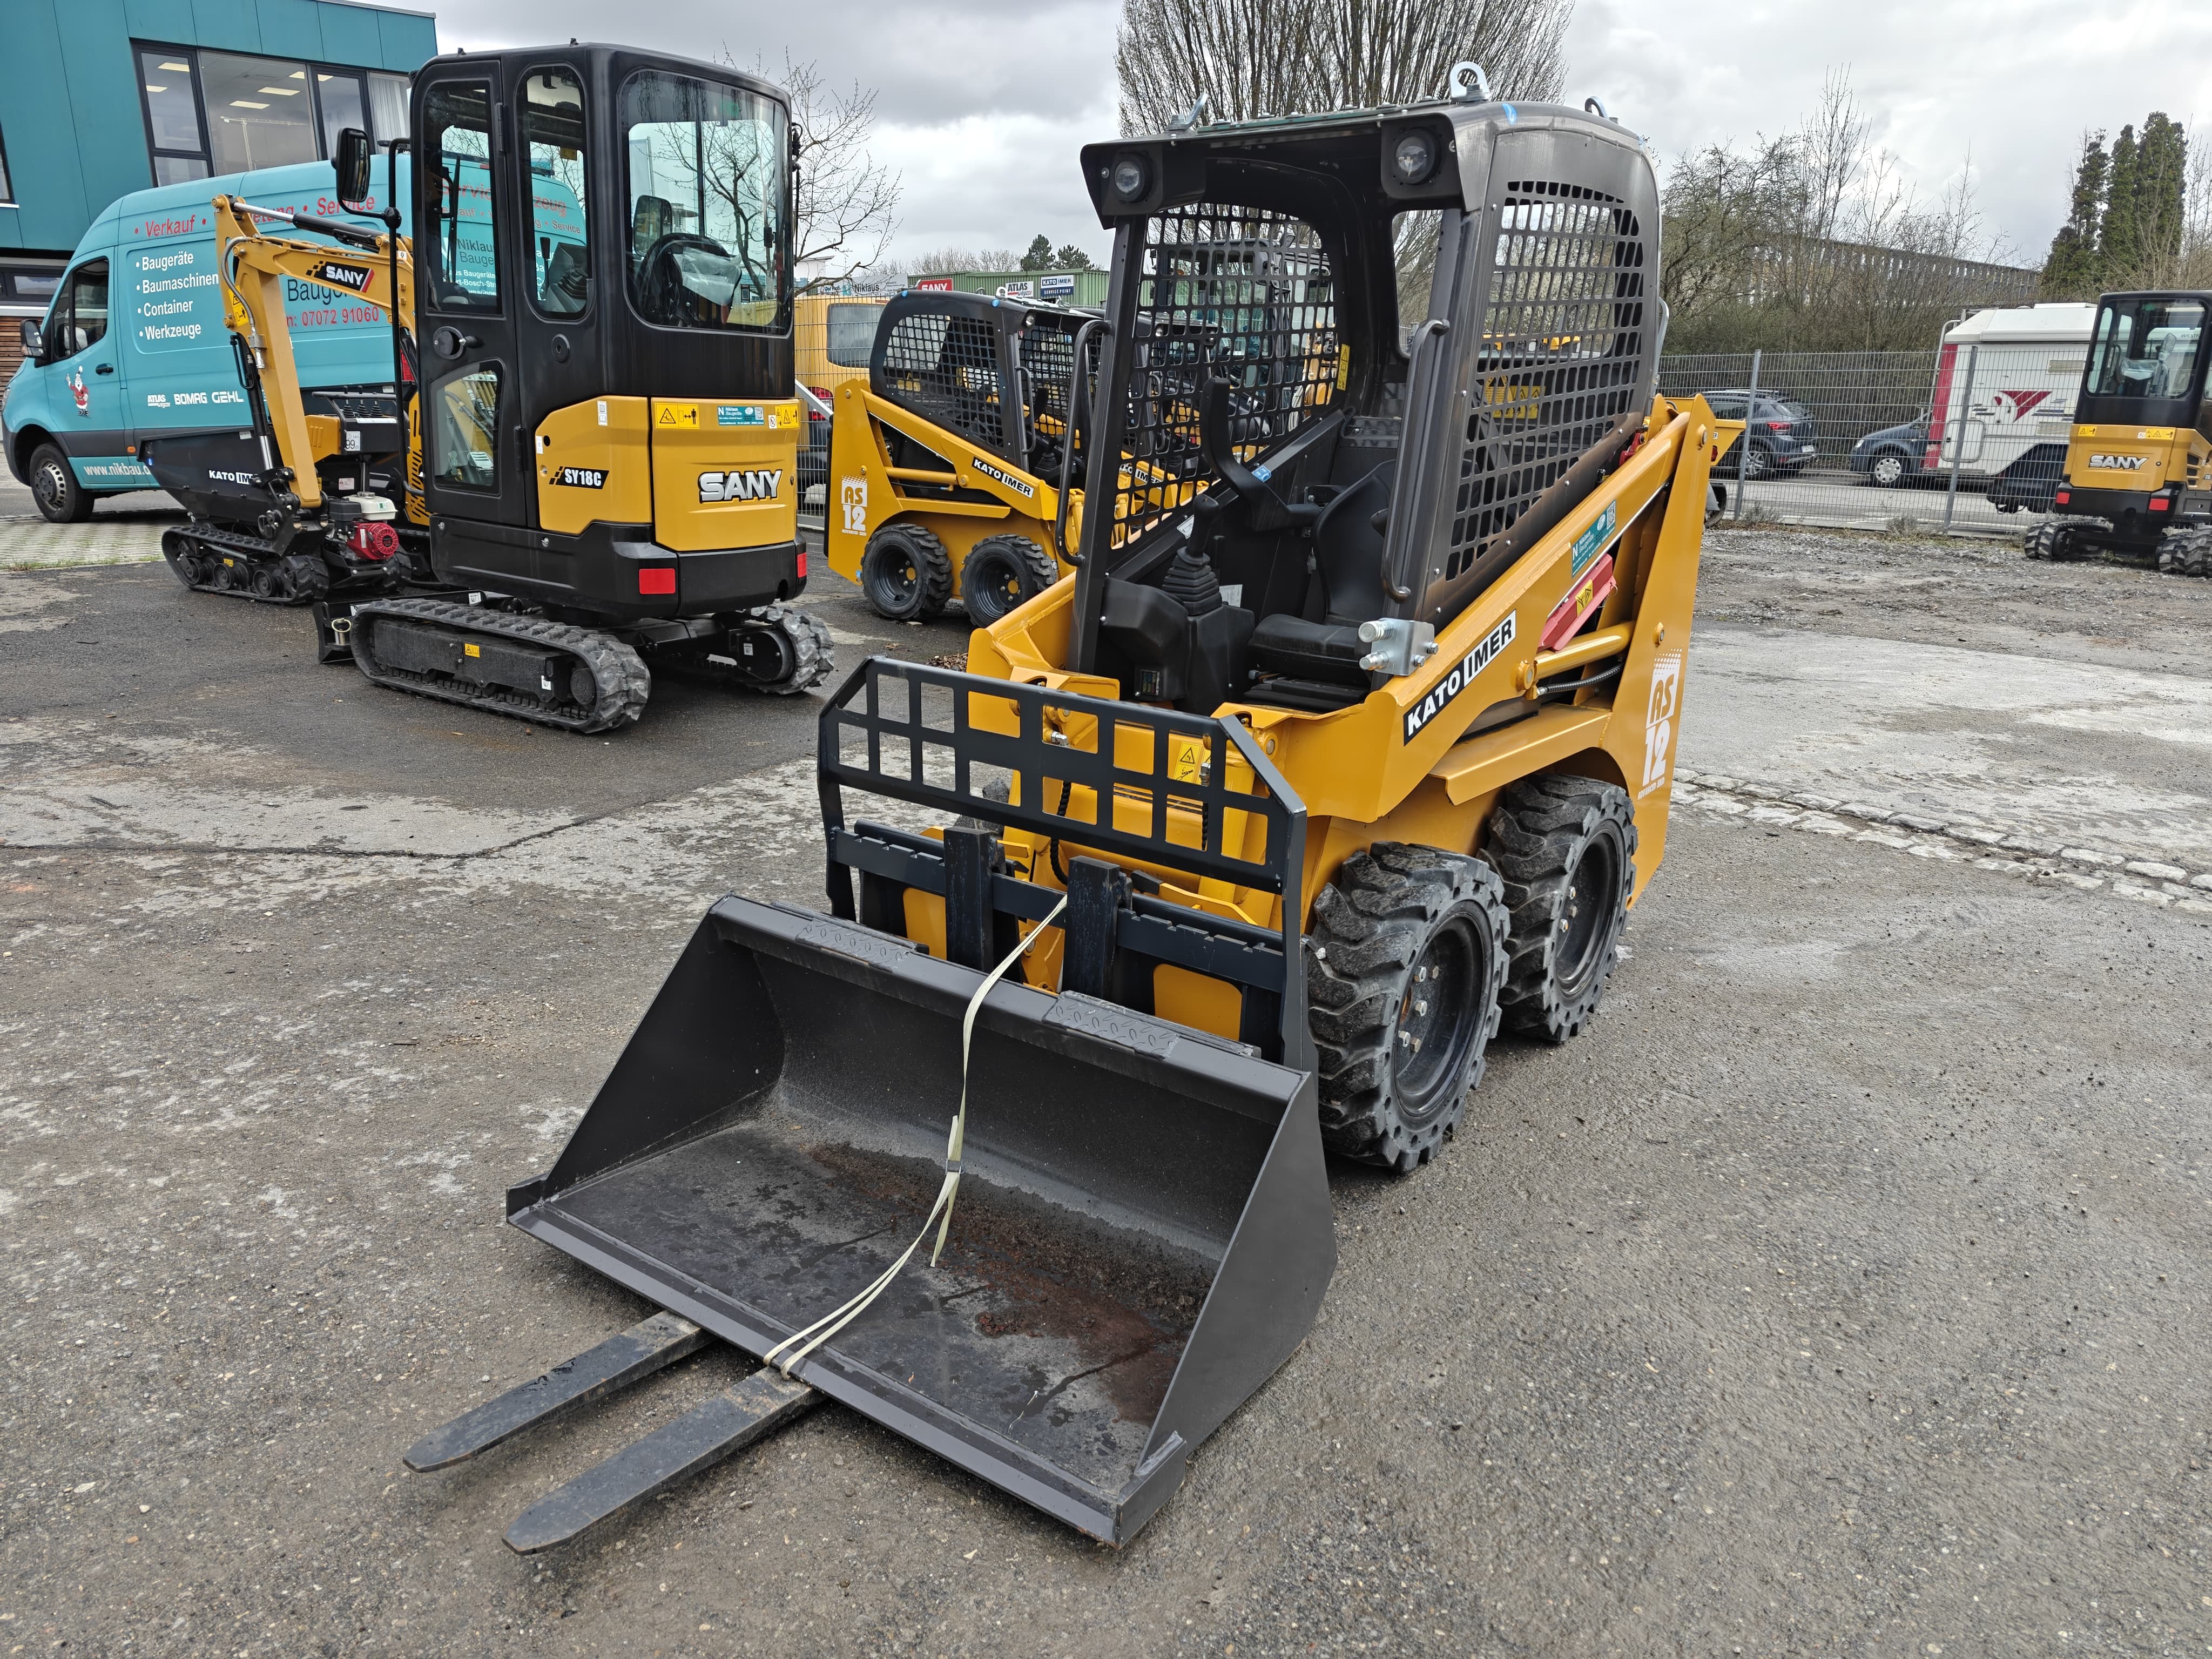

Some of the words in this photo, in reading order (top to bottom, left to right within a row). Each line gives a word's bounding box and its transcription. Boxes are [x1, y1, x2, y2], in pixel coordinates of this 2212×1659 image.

[145, 215, 195, 237] Verkauf
[552, 220, 580, 233] Service
[457, 238, 493, 252] Niklau
[142, 251, 194, 271] Baugeräte
[460, 251, 494, 267] Bauge
[143, 272, 219, 293] Baumaschinen
[326, 265, 363, 286] SANY
[854, 284, 879, 293] Niklaus
[922, 283, 947, 291] SANY
[1008, 283, 1027, 292] ATLAS
[144, 300, 193, 316] Container
[302, 309, 338, 326] 07072
[342, 306, 379, 323] 91060
[145, 323, 201, 340] Werkzeuge
[147, 394, 166, 403] ATLAS
[173, 392, 208, 405] BOMAG
[211, 390, 244, 403] GEHL
[346, 439, 355, 449] 99
[83, 462, 151, 476] www.nikbau.d
[2090, 455, 2149, 470] SANY
[208, 470, 235, 482] KATO
[564, 468, 602, 487] SY18C
[974, 459, 1001, 479] KATO
[1004, 475, 1031, 495] IMER
[699, 469, 783, 503] SANY
[844, 486, 863, 505] AS
[842, 503, 866, 532] 12
[1408, 670, 1460, 736] KATO
[1468, 619, 1512, 679] IMER
[1650, 673, 1675, 725] AS
[1642, 719, 1670, 787] 12
